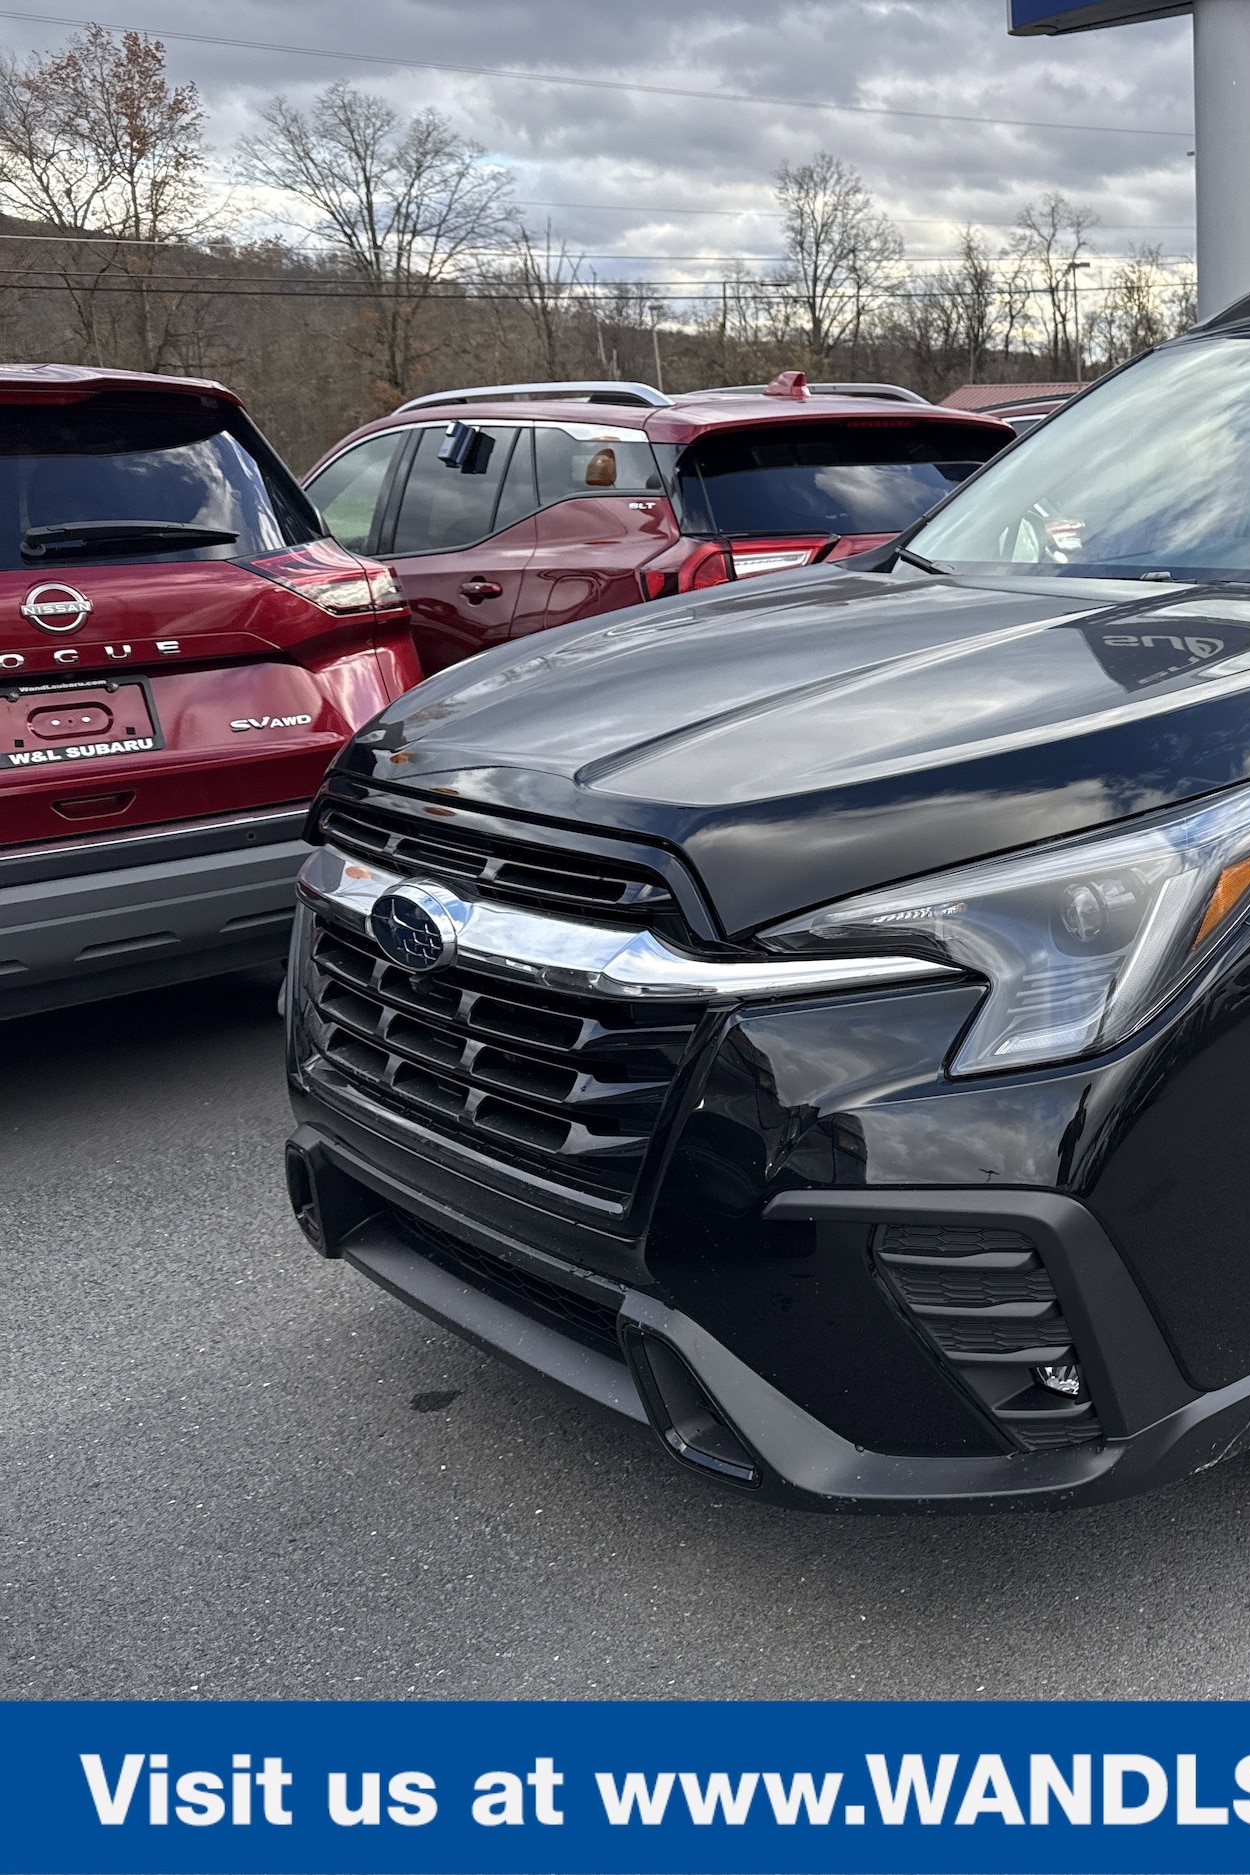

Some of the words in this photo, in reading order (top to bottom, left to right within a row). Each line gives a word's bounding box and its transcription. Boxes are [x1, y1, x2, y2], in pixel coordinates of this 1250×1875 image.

[628, 502, 656, 510] SLT
[23, 603, 90, 615] NISSAN
[9, 748, 63, 766] W&L
[66, 737, 154, 759] SUBARU
